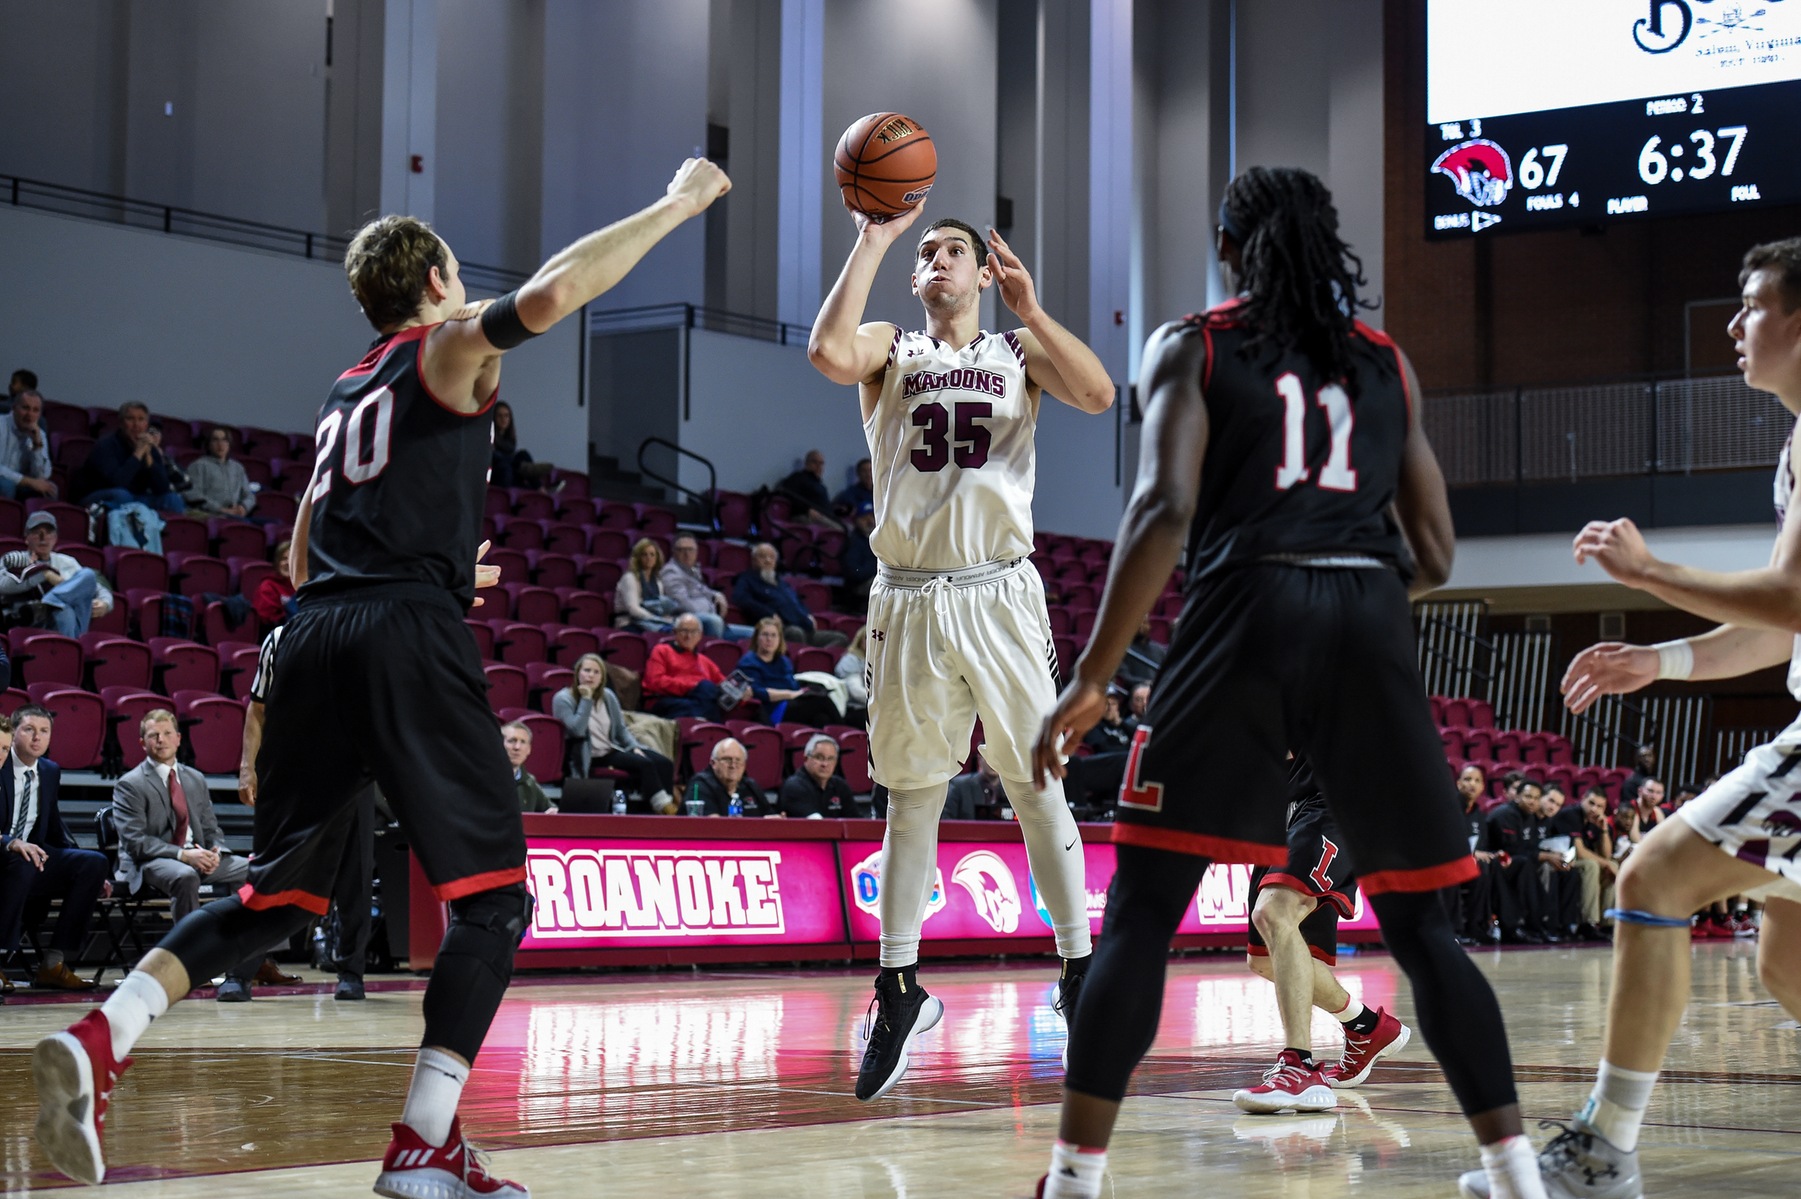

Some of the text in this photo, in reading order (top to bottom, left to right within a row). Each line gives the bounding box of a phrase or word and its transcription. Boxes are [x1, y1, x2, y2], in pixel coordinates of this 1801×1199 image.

[1469, 118, 1482, 138] 3
[1690, 93, 1704, 115] 2
[1519, 143, 1569, 190] 67
[1638, 125, 1748, 185] 6:37
[1526, 191, 1580, 212] FOULS 4
[902, 367, 1006, 400] MAROONS
[311, 384, 395, 506] 20
[910, 401, 993, 473] 35
[1274, 370, 1358, 492] 11
[1117, 724, 1165, 813] L
[528, 850, 784, 936] ROANOKE
